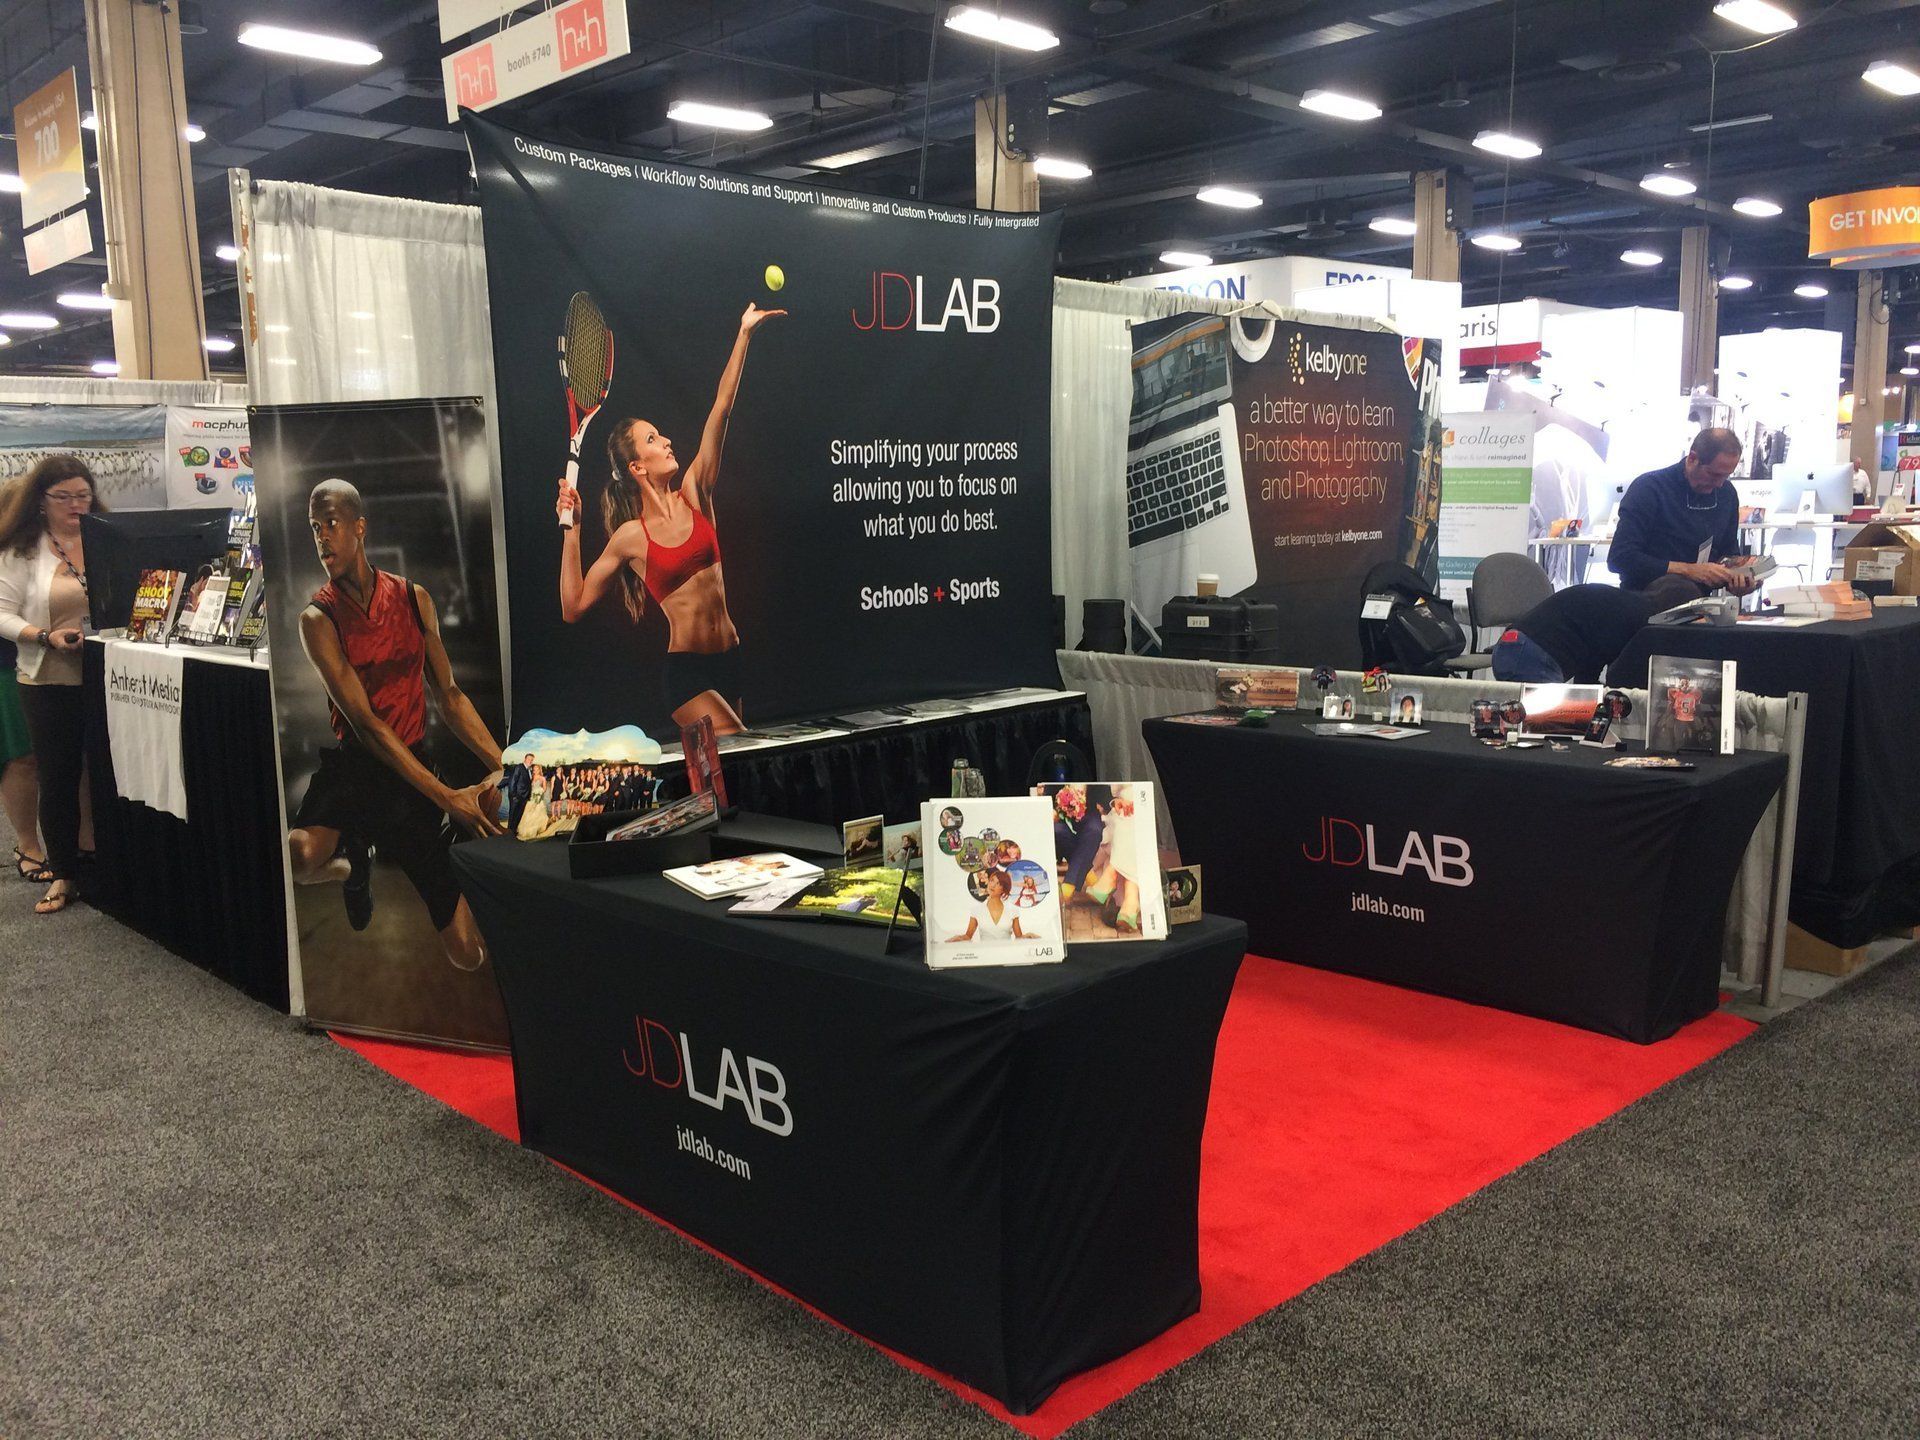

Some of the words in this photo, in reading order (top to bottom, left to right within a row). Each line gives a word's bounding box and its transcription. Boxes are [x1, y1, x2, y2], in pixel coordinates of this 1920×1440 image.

[507, 53, 531, 73] booth
[532, 43, 552, 64] #740
[34, 120, 60, 168] 700
[514, 136, 567, 165] Custom
[570, 152, 632, 178] Packages
[641, 165, 696, 188] Workflow
[699, 174, 750, 195] Solutions
[752, 182, 772, 198] and
[774, 185, 814, 205] Support
[821, 192, 870, 212] Innovative
[872, 201, 890, 215] and
[892, 203, 927, 220] Custom
[928, 210, 967, 225] Products
[973, 215, 993, 229] Fully
[995, 216, 1040, 230] Intergrated
[1829, 210, 1866, 231] GET
[852, 271, 1001, 334] JDLAB
[1154, 274, 1246, 300] SON
[1305, 342, 1368, 381] kelbyone
[1249, 400, 1260, 425] a
[1264, 393, 1309, 424] better
[1312, 402, 1344, 433] way
[1345, 399, 1360, 427] to
[1362, 397, 1395, 428] learn
[830, 439, 921, 469] Simplifying
[926, 442, 960, 468] your
[964, 441, 1018, 466] process
[1244, 433, 1330, 469] Photoshop,
[1333, 434, 1404, 469] Lightroom,
[1459, 426, 1526, 449] collages
[1487, 454, 1527, 463] reimagined
[833, 476, 902, 505] allowing
[906, 479, 934, 504] you
[938, 474, 954, 498] to
[957, 473, 997, 497] focus
[1000, 476, 1017, 496] on
[1261, 470, 1292, 501] and
[1295, 470, 1387, 505] Photography
[863, 513, 905, 538] what
[908, 515, 936, 540] you
[941, 509, 959, 533] do
[963, 507, 998, 531] best.
[1274, 533, 1291, 547] start
[1290, 531, 1316, 547] learning
[1316, 531, 1334, 546] today
[1334, 532, 1341, 543] at
[1341, 529, 1383, 544] kelbyone.com
[135, 597, 168, 610] MACRO
[138, 586, 172, 598] SHOOT
[860, 582, 929, 611] Schools
[950, 576, 1000, 606] Sports
[1302, 815, 1475, 887] JDLAB
[1351, 892, 1425, 923] jdlab.com
[622, 1015, 794, 1137] JDLAB
[676, 1124, 751, 1181] jdlab.com
